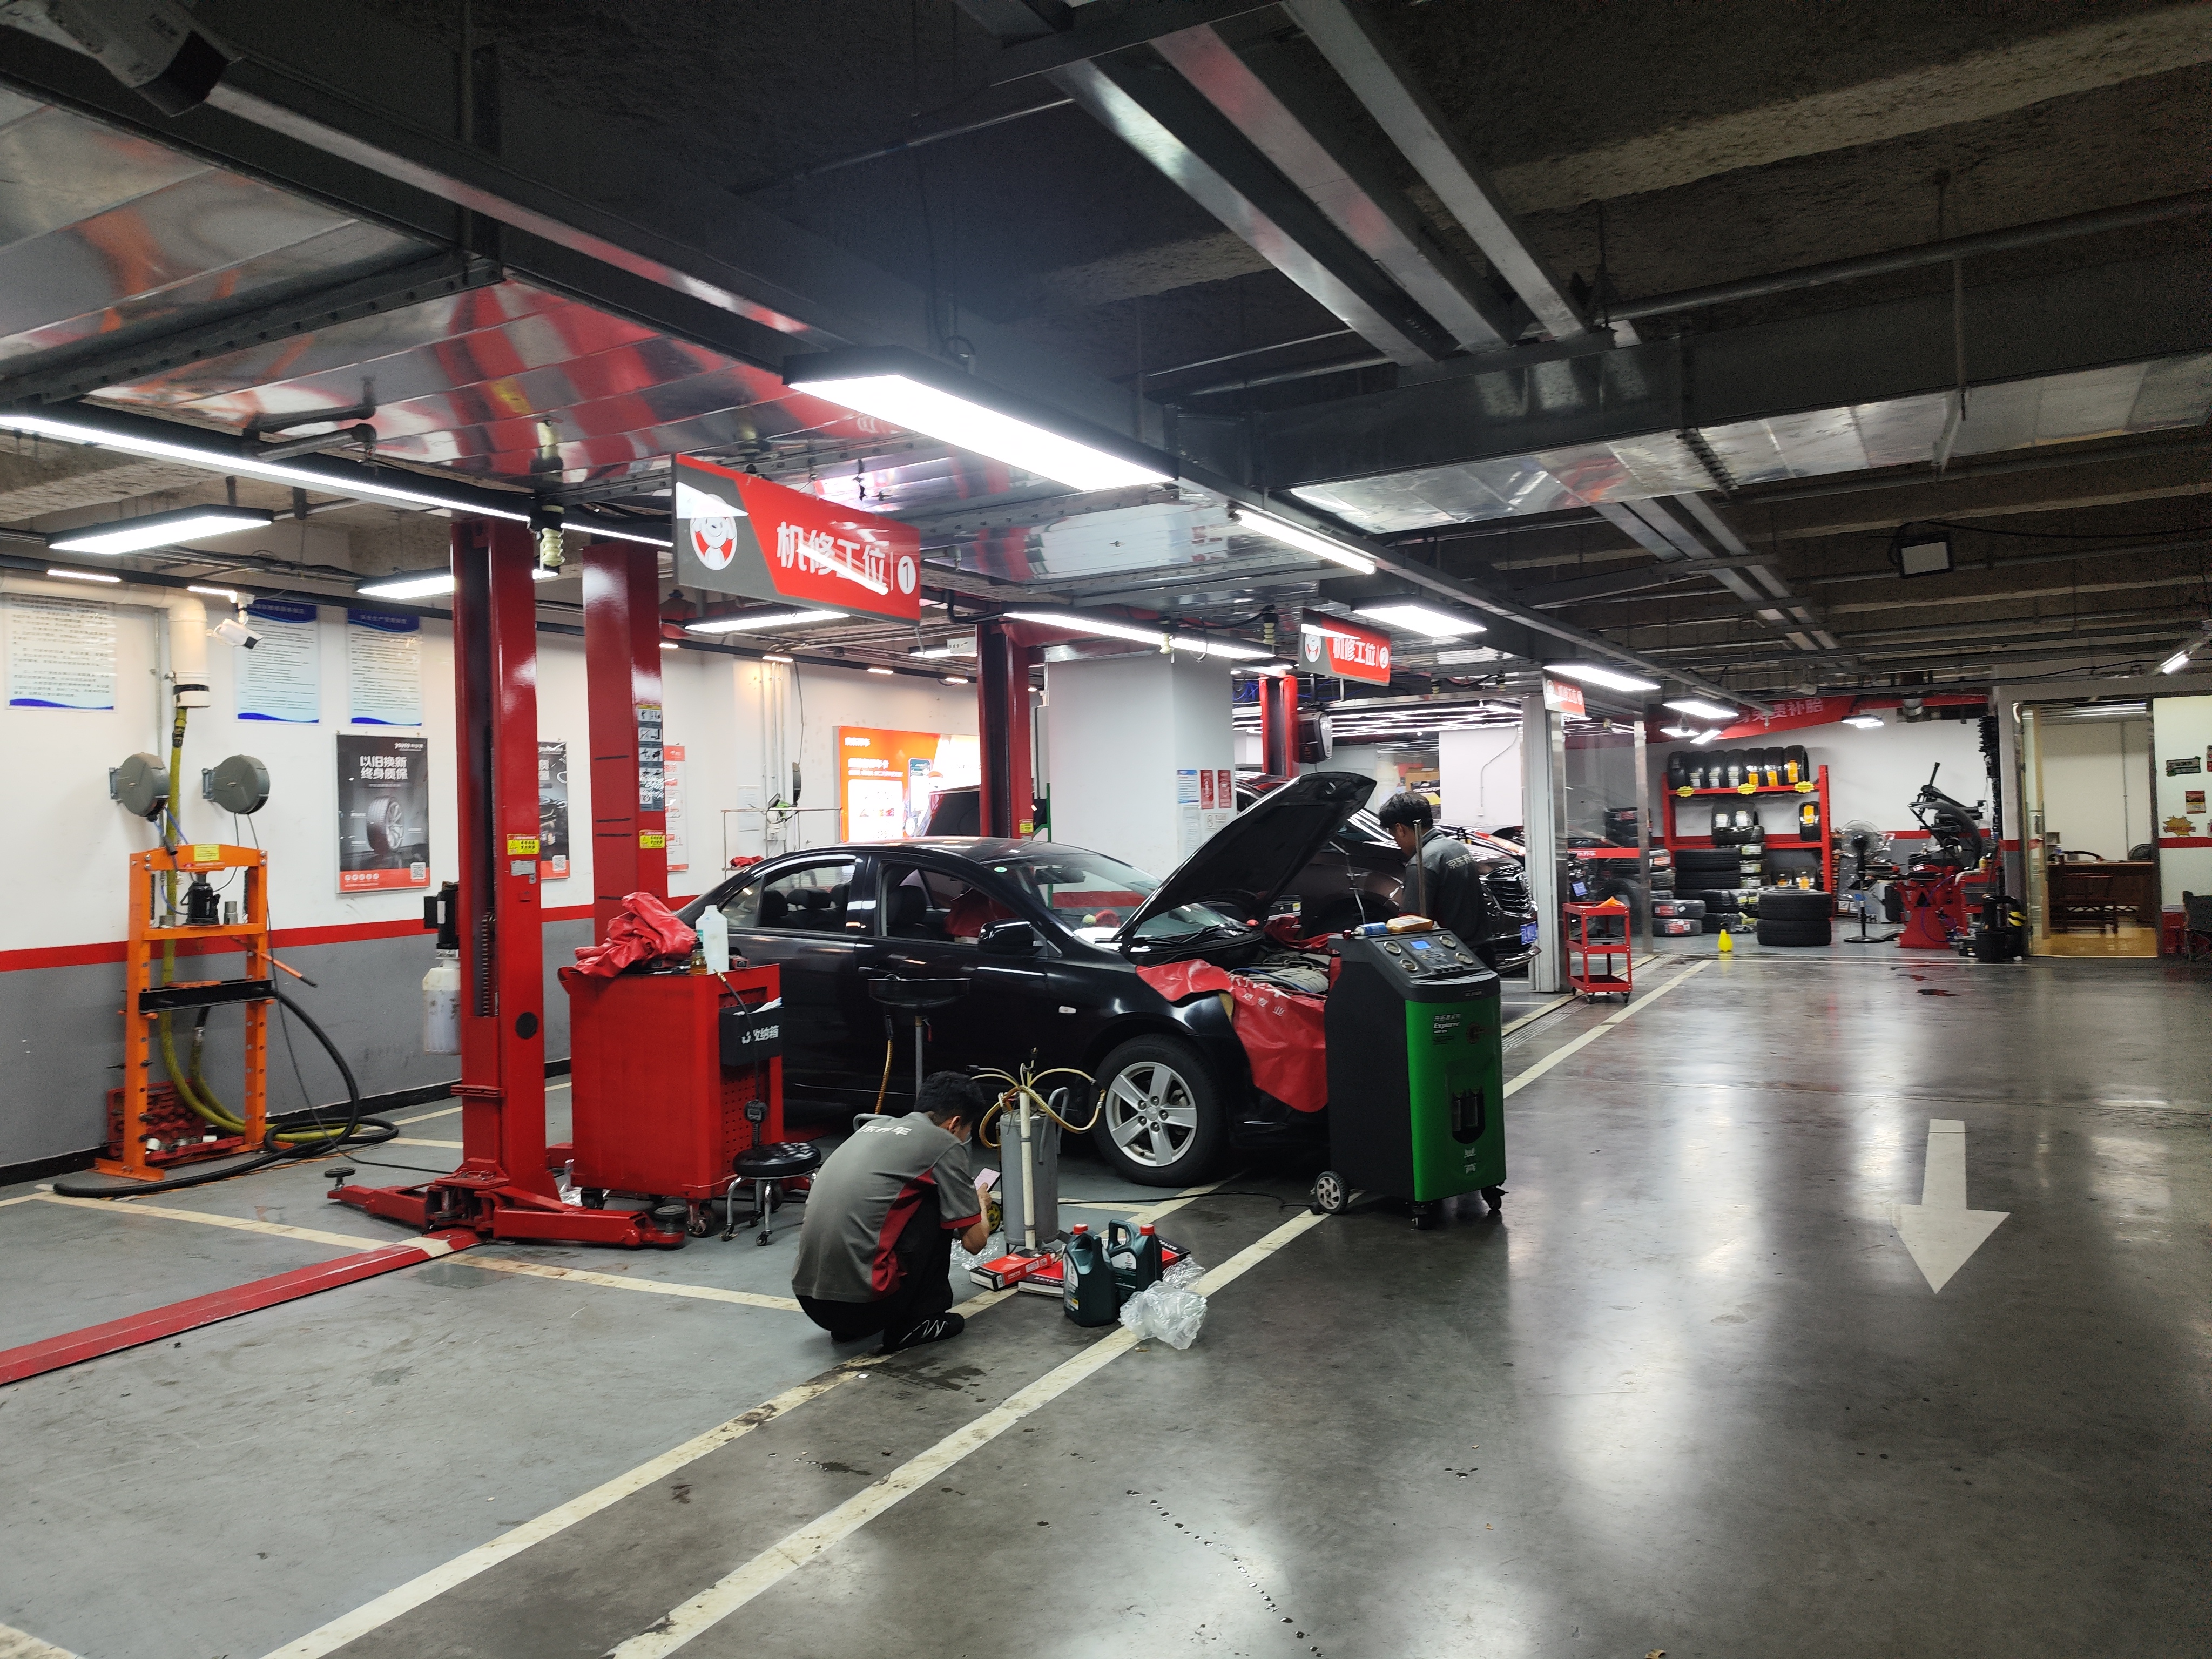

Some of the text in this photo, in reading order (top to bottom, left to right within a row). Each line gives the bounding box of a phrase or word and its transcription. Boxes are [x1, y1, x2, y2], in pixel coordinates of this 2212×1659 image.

[776, 521, 888, 589] 机修工位
[1332, 637, 1376, 667] 机修工位
[359, 755, 407, 768] 以旧换新
[360, 767, 408, 780] 终身质保
[753, 1024, 780, 1042] 收纳箱
